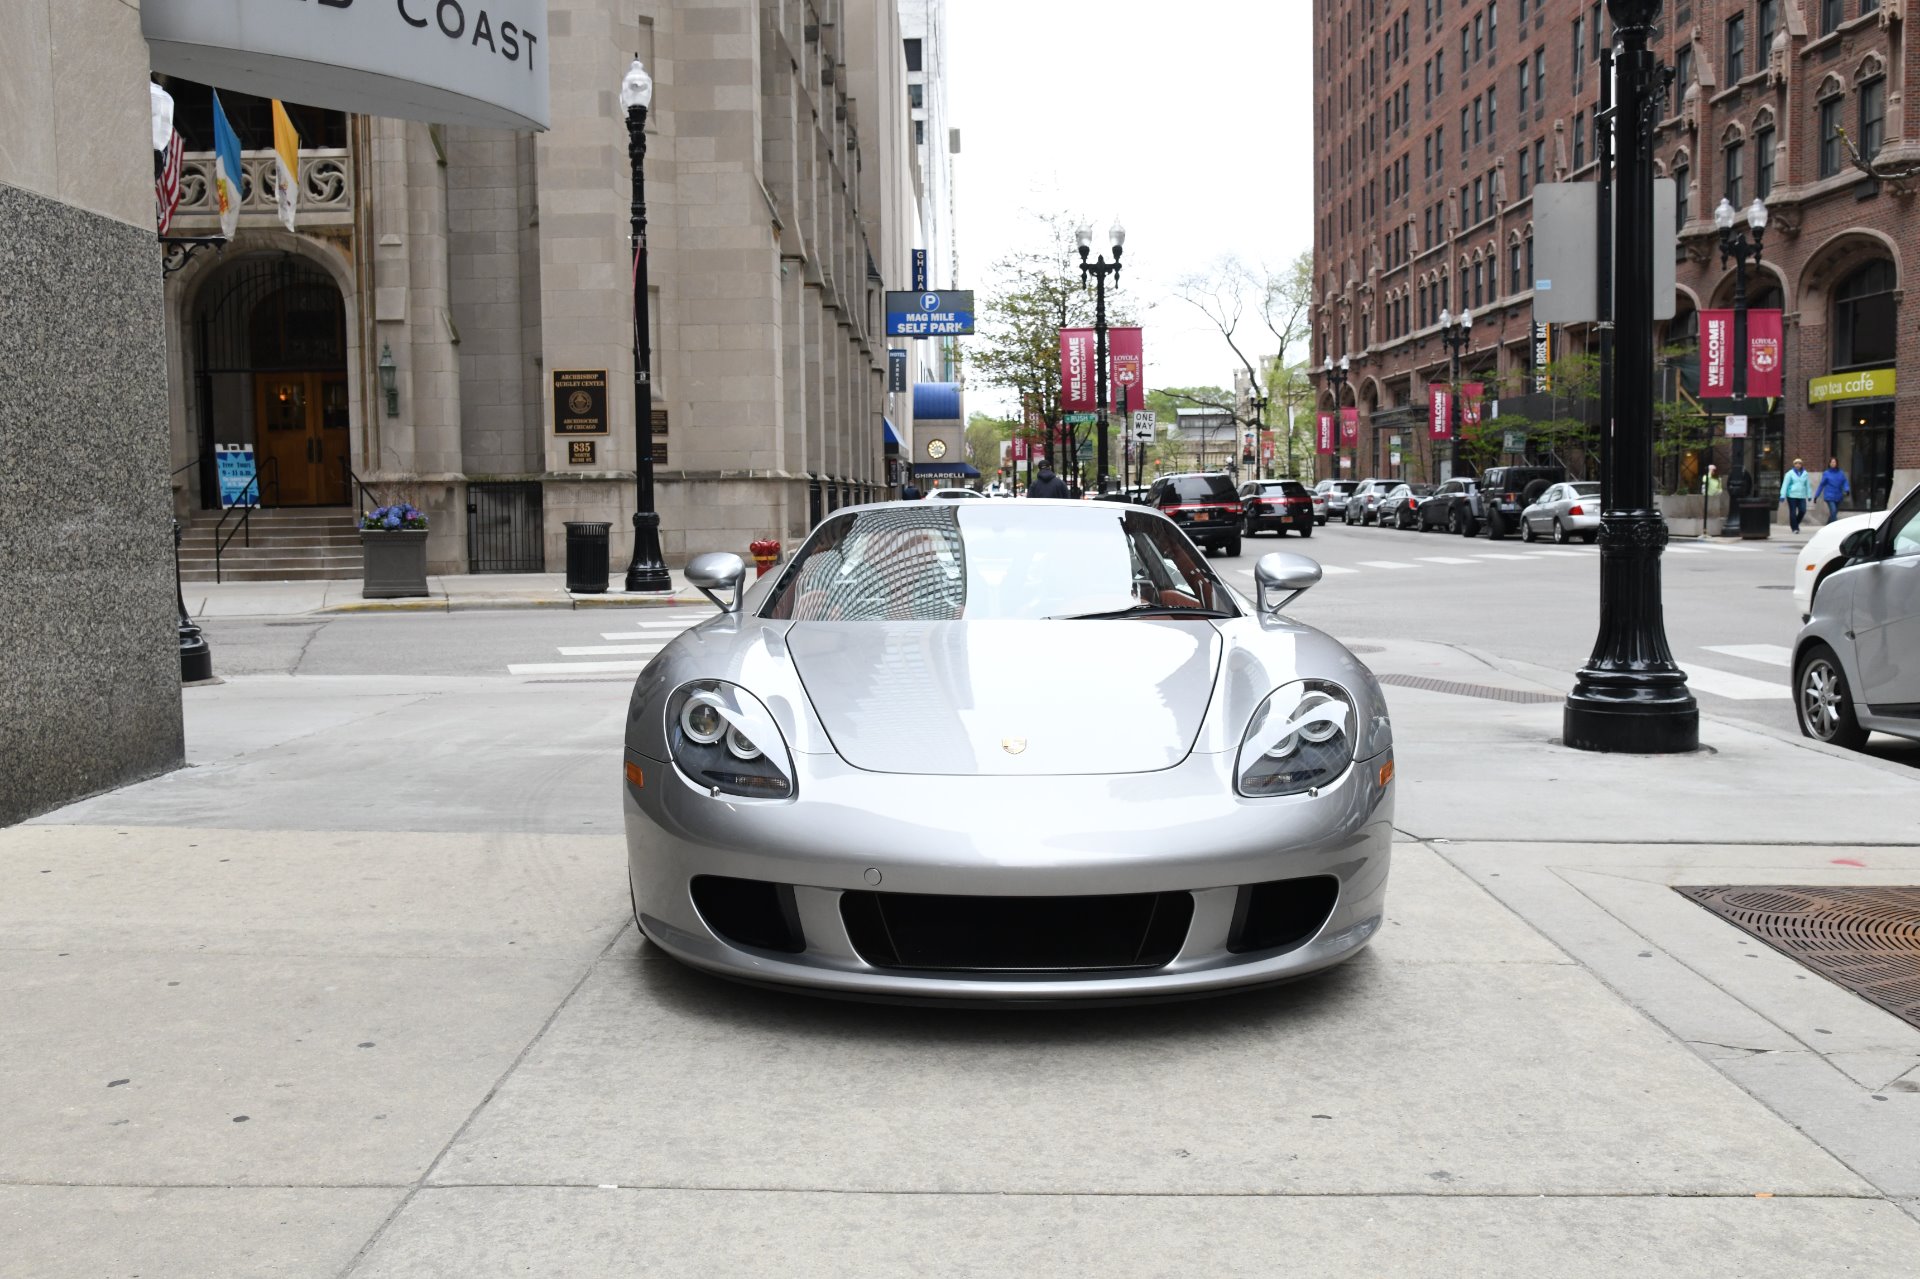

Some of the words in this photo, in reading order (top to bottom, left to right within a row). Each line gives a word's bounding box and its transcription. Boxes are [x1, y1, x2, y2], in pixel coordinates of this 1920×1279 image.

[397, 0, 537, 71] COAST
[925, 295, 936, 309] P
[906, 313, 928, 322] MAG
[931, 313, 955, 322] MILE
[897, 323, 927, 333] SELF
[930, 322, 963, 333] PARK
[1708, 320, 1719, 387] WELCOME
[1069, 337, 1080, 401] WELCOME
[1829, 382, 1842, 394] tea
[1845, 372, 1874, 393] café
[1136, 412, 1153, 421] ONE
[1434, 391, 1442, 433] WELCOME
[1135, 421, 1153, 430] WAY
[573, 442, 591, 453] 835
